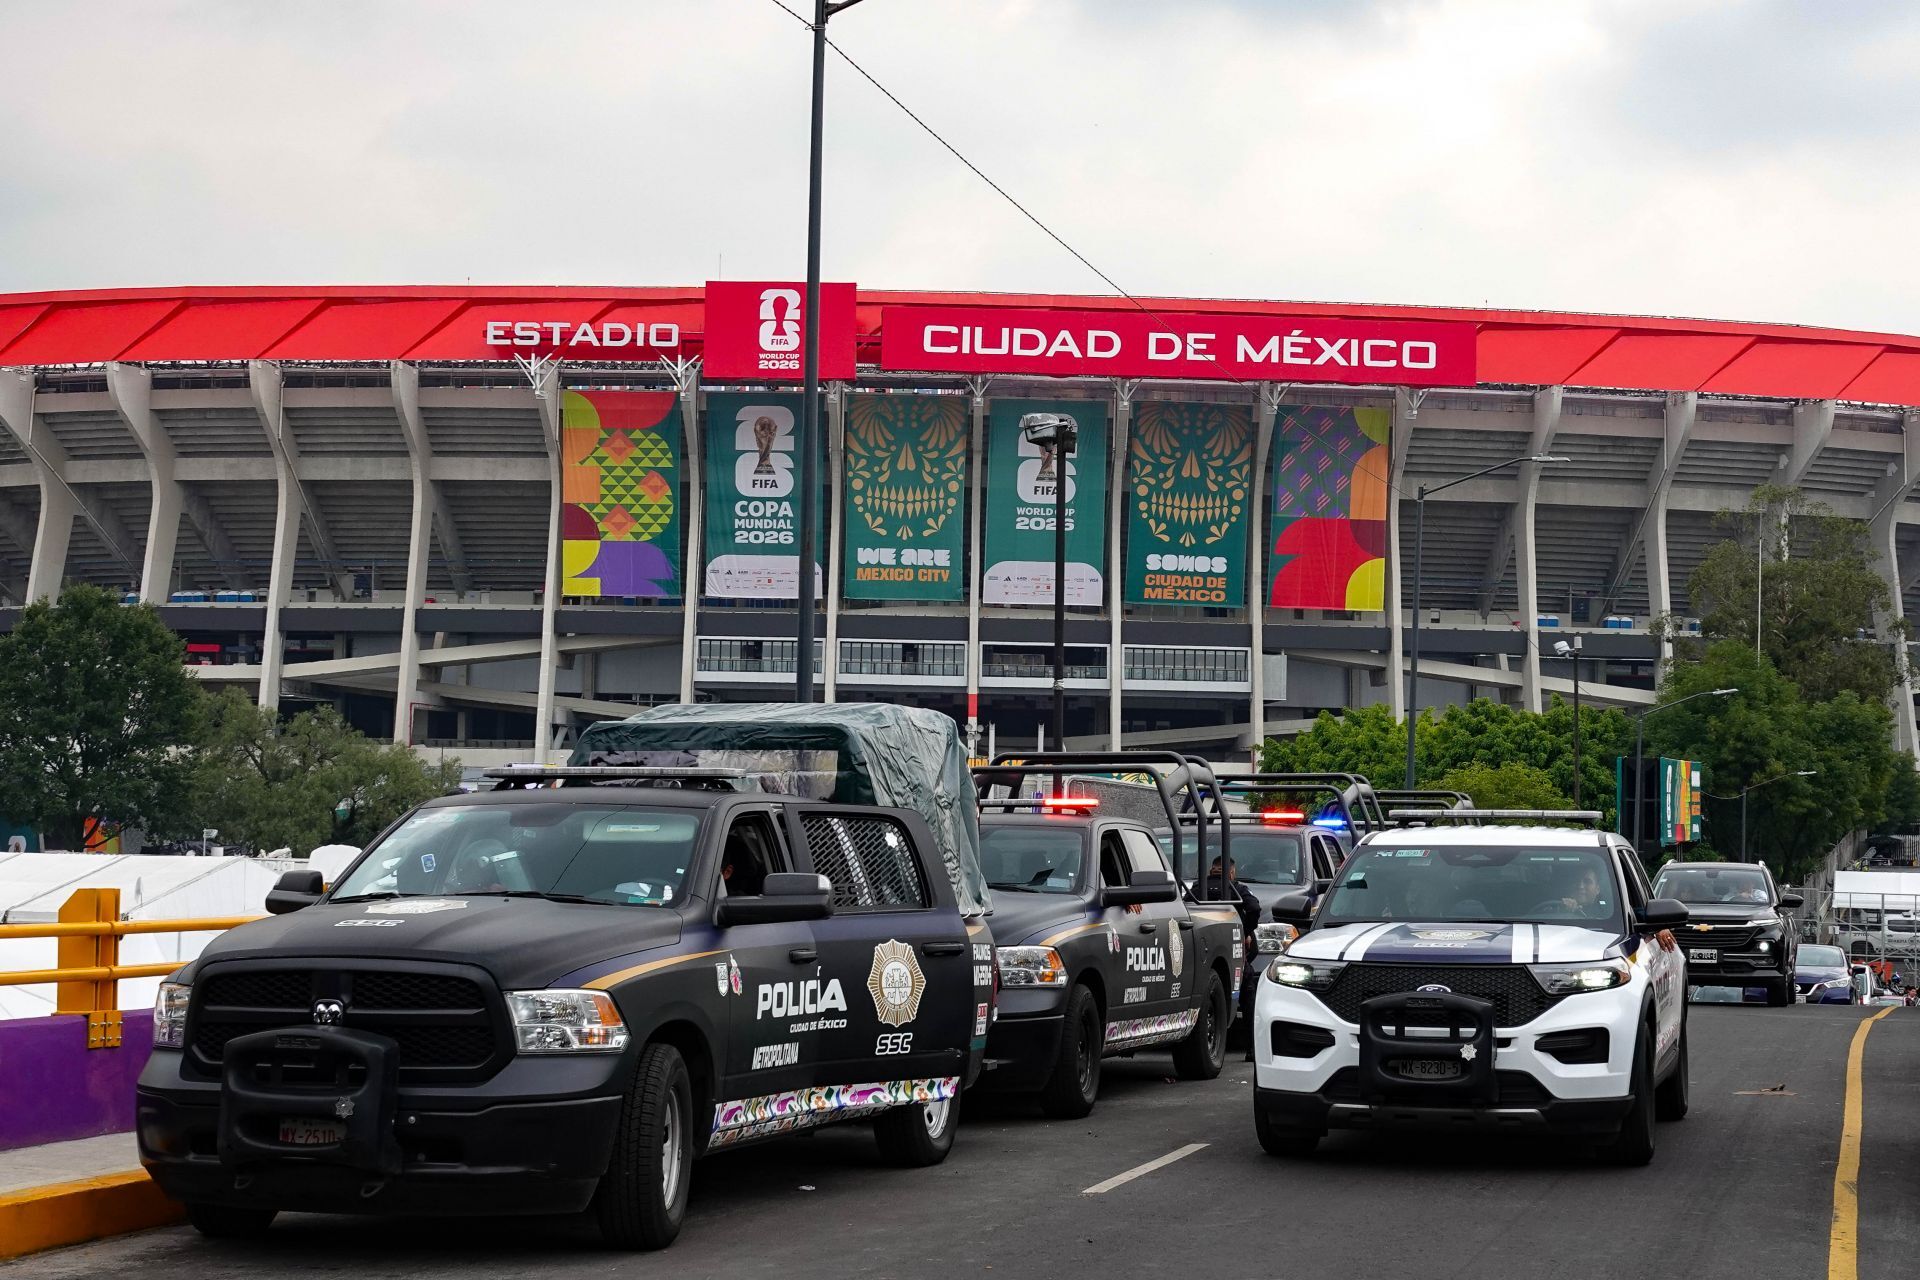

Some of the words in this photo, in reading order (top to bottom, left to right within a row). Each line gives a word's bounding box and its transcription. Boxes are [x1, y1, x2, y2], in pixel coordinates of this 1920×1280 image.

[487, 322, 679, 347] ESTADIO
[923, 325, 1121, 358] CIUDAD
[1148, 332, 1216, 361] DE
[1236, 329, 1437, 369] MÉXICO
[759, 360, 799, 369] 2026
[752, 479, 778, 488] FIFA
[1034, 486, 1057, 495] FIFA
[735, 501, 794, 517] COPA
[1016, 506, 1053, 516] WORLD
[1055, 508, 1075, 516] UP
[735, 519, 793, 529] MUNDIAL
[1016, 517, 1074, 531] 2026
[735, 531, 794, 544] 2026
[857, 548, 896, 565] WE
[901, 549, 950, 566] ARE
[1146, 554, 1227, 573] SOMOS
[857, 568, 914, 581] MEXICO
[918, 569, 949, 582] CITY
[1145, 574, 1203, 588] CIUDAD
[1207, 577, 1227, 588] DE
[1144, 586, 1226, 602] MÉXICO
[1126, 938, 1166, 971] POLICÍA
[757, 966, 847, 1020] POLICÍA
[789, 1022, 809, 1033] CIUDAD
[810, 1021, 817, 1031] DE
[875, 1033, 913, 1055] SSC
